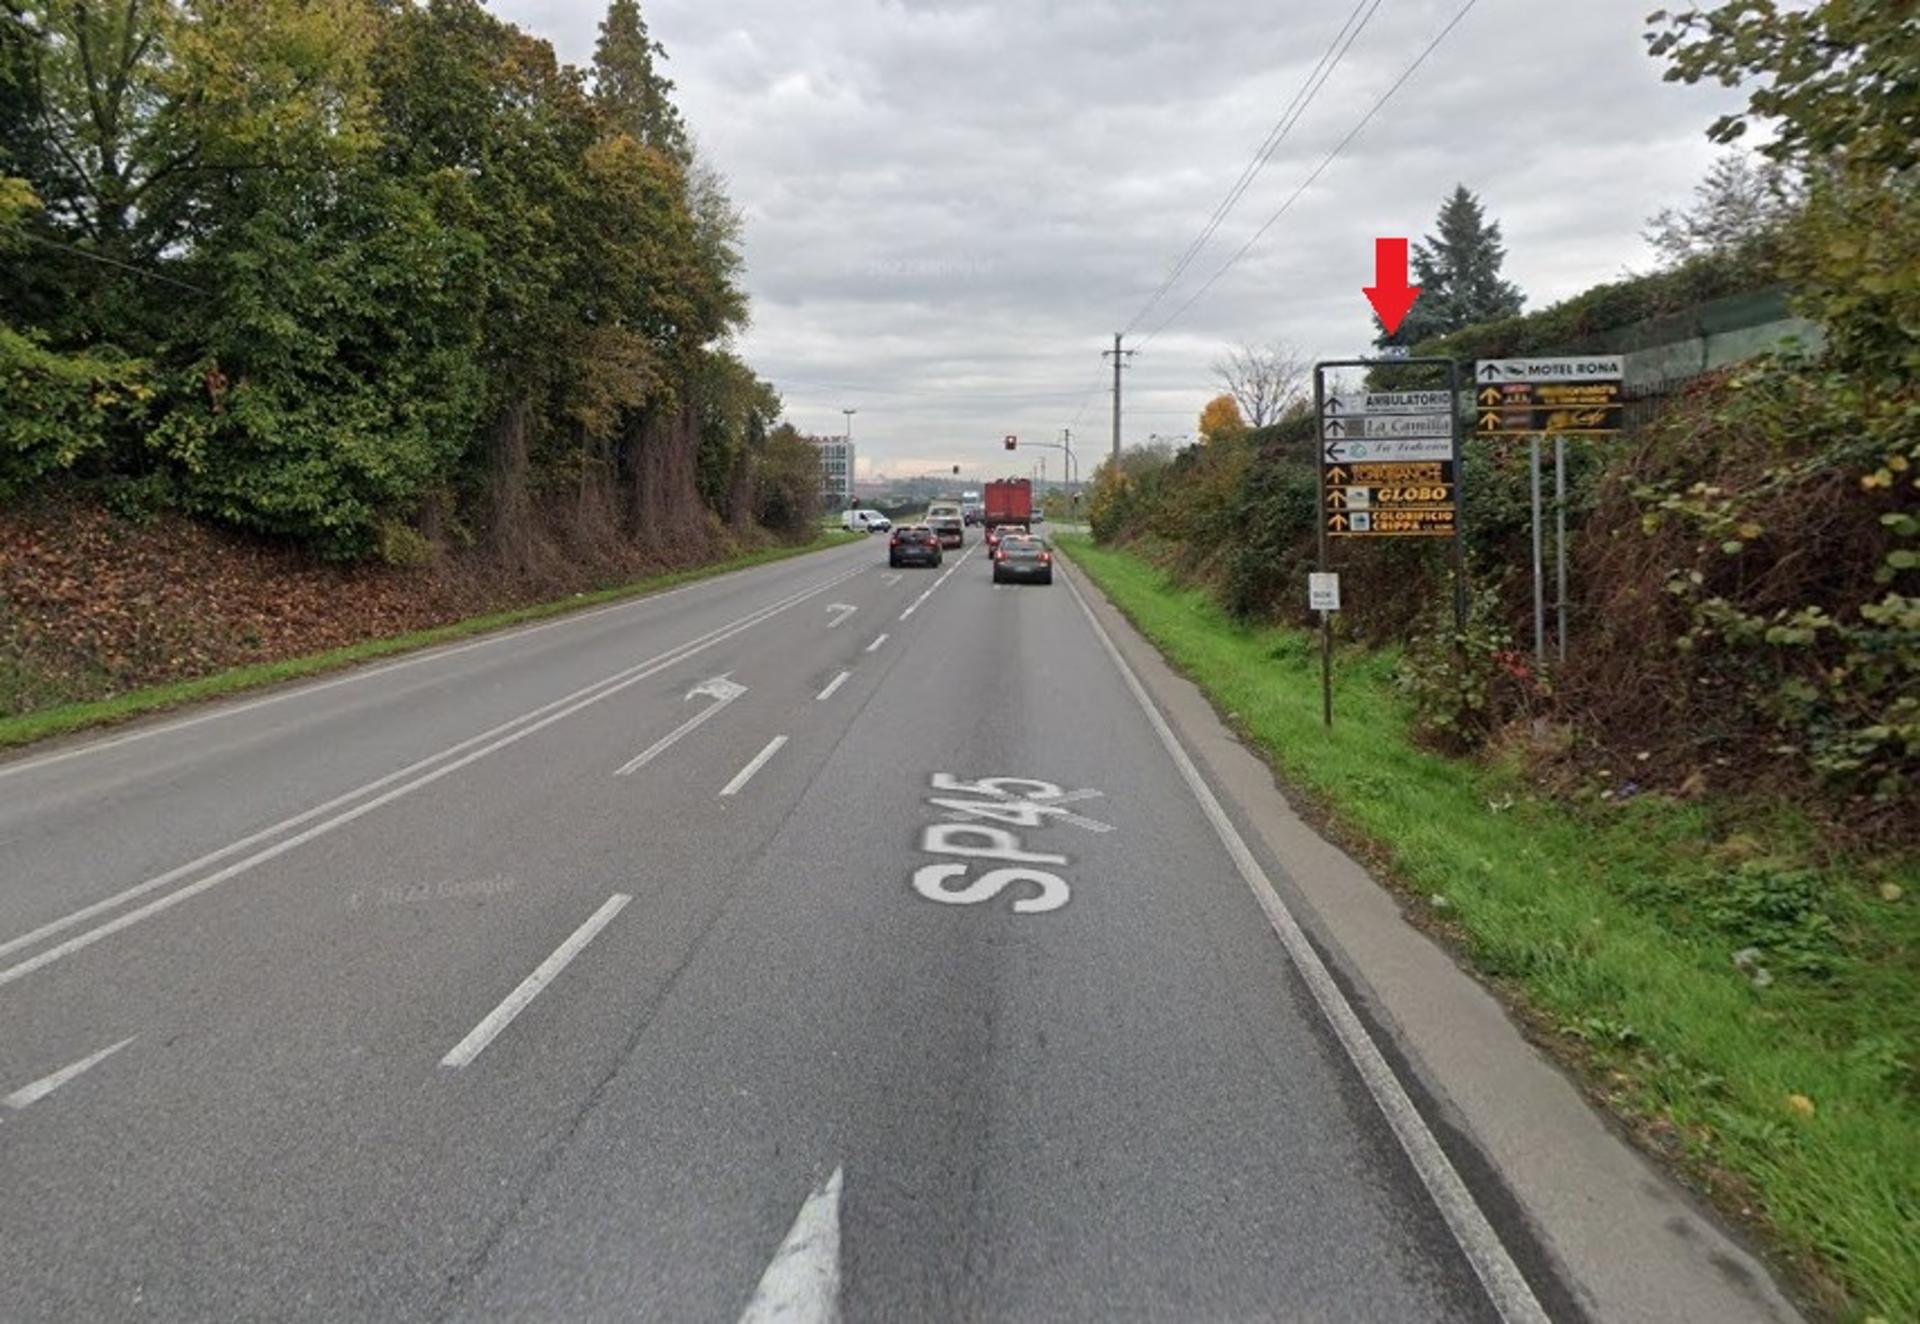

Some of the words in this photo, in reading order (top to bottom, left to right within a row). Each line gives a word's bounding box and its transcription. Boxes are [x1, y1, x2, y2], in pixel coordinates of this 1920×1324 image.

[1528, 365, 1573, 376] MOTEL
[1576, 362, 1619, 374] RONA
[1366, 393, 1450, 407] AMBULATORIO
[1377, 486, 1448, 502] GLOBO
